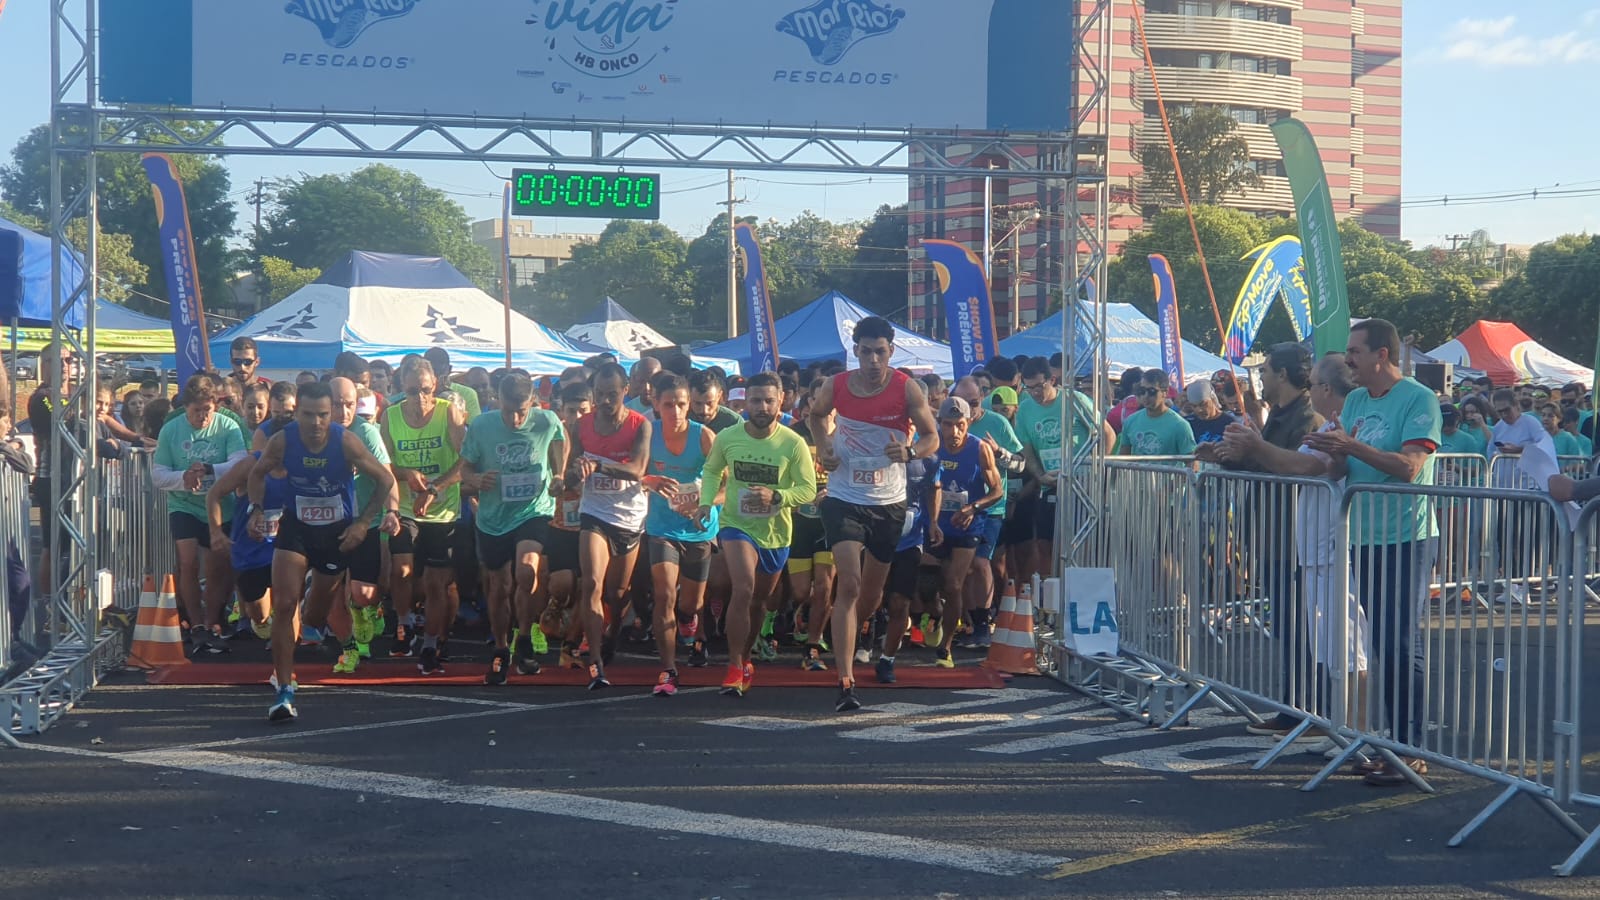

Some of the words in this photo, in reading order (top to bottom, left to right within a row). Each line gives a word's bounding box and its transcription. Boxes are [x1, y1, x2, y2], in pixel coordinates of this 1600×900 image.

[846, 2, 889, 29] Rio
[282, 53, 409, 69] PESCADOS
[574, 52, 595, 69] HB
[599, 53, 639, 71] ONCO
[773, 70, 893, 85] PESCADOS
[516, 174, 653, 208] 00:00:00
[1311, 234, 1327, 311] Unimed
[967, 296, 982, 339] SHOW
[957, 302, 974, 363] PRÊMIOS
[974, 343, 985, 361] DE
[401, 438, 439, 450] PETER'S
[303, 457, 328, 468] ESPF
[595, 478, 620, 490] 250
[855, 471, 881, 483] 269
[510, 486, 534, 497] 122
[674, 492, 698, 504] 400
[303, 507, 333, 520] 420
[1069, 601, 1118, 635] LA
